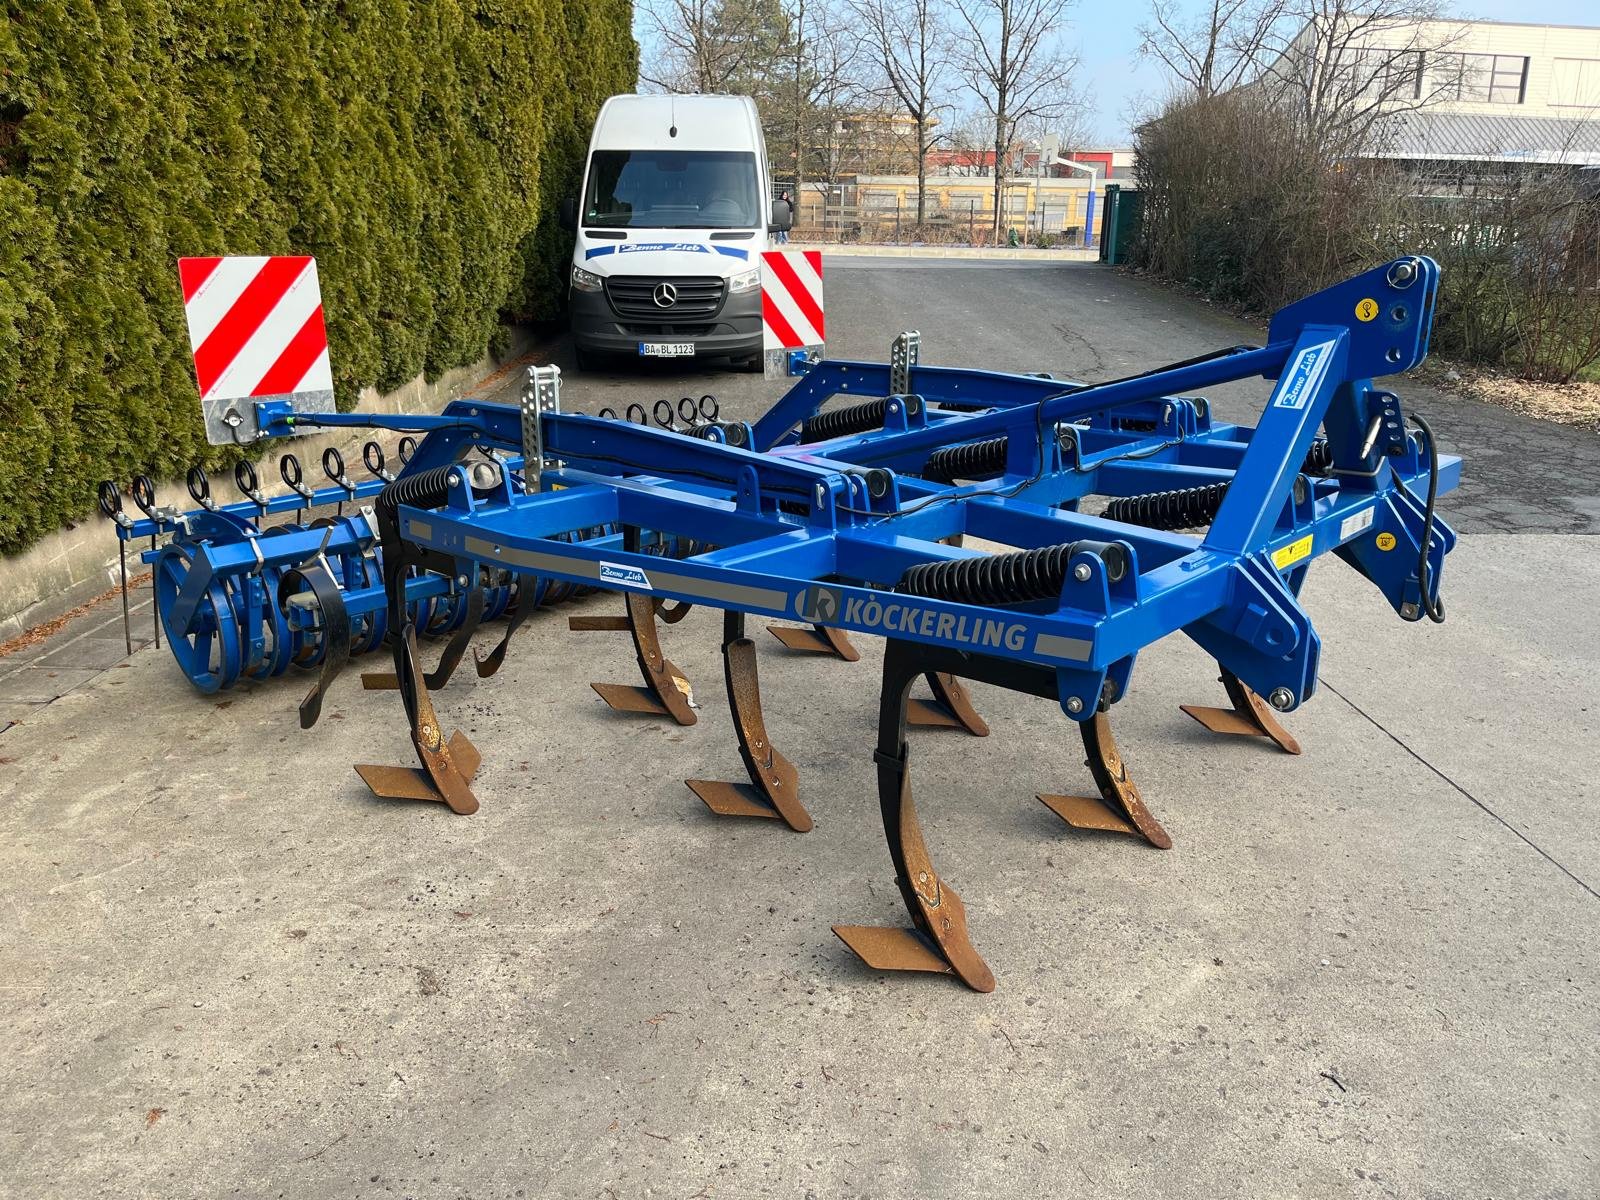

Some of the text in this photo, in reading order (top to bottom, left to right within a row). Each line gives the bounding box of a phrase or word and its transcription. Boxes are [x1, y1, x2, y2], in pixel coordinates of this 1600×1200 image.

[621, 244, 700, 252] Benno Lieb
[645, 345, 694, 354] BA BL 1123
[601, 566, 642, 581] Benno Lieb
